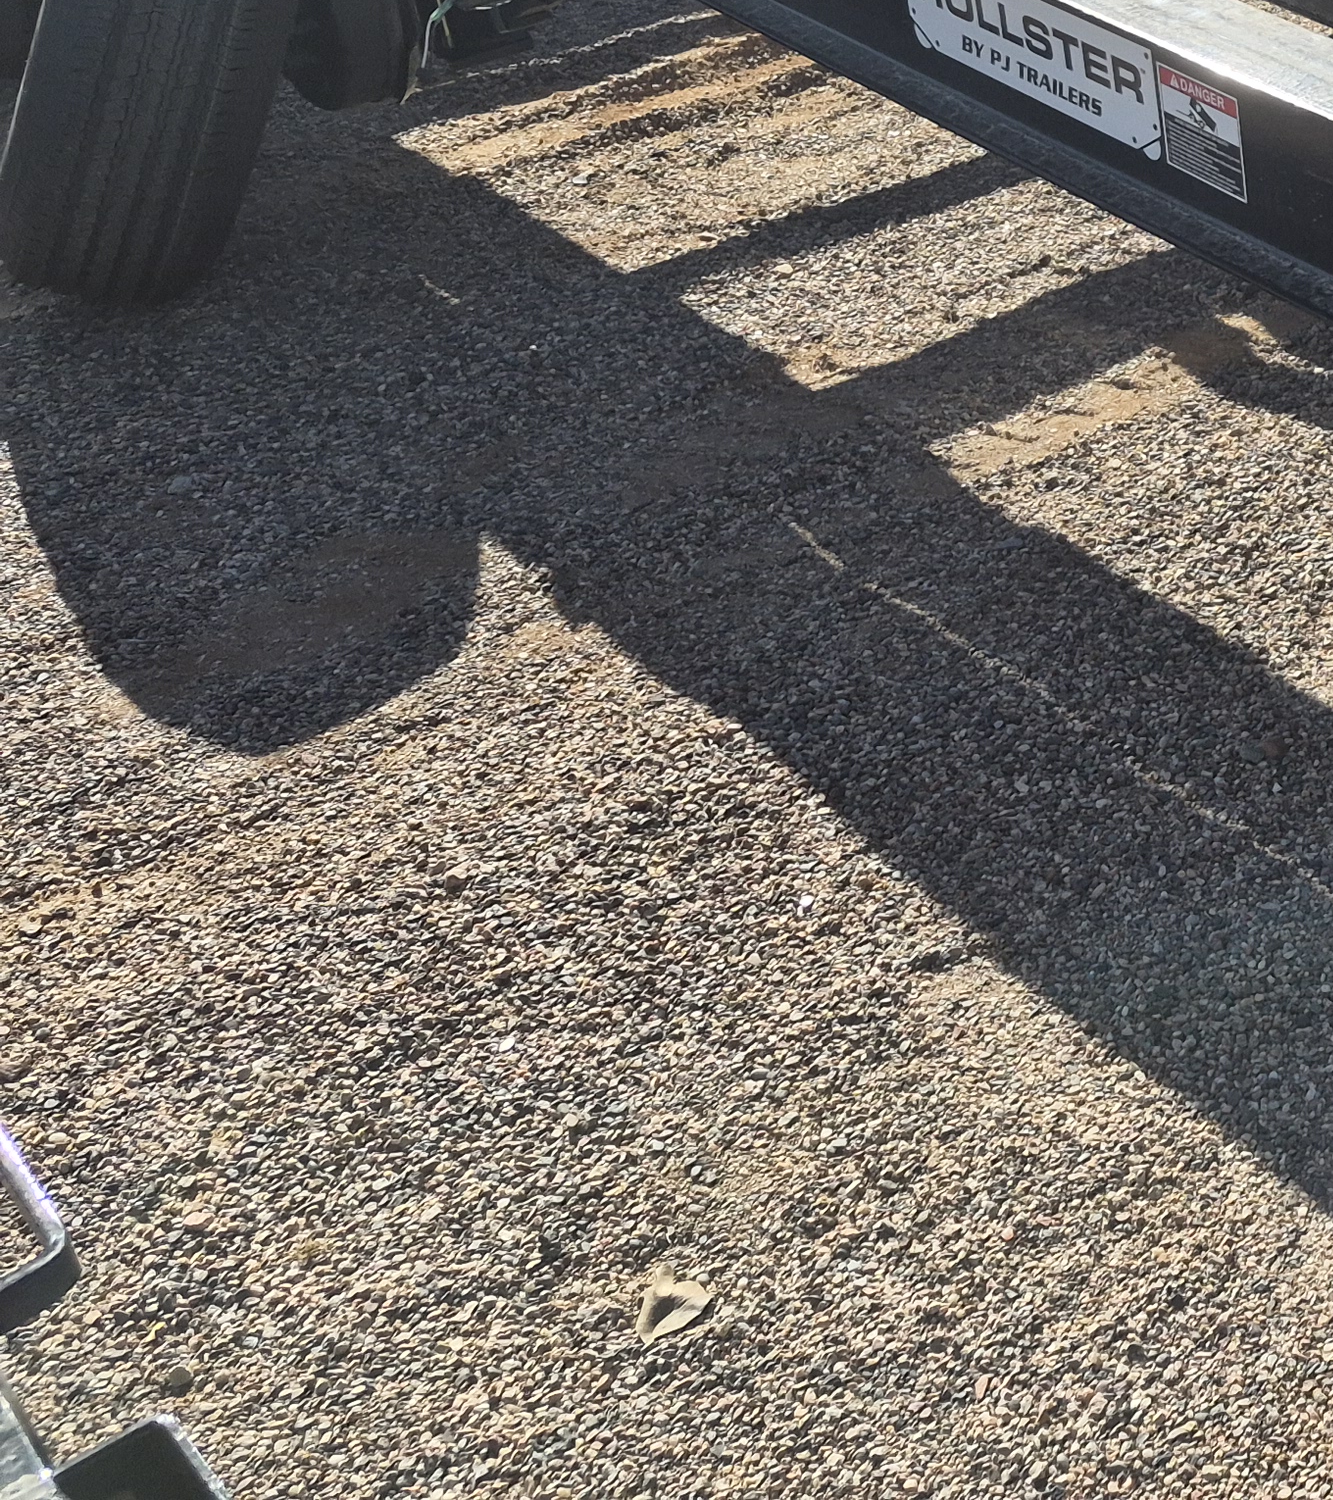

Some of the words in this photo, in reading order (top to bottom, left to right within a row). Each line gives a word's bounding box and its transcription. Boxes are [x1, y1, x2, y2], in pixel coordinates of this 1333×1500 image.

[961, 34, 984, 59] BY
[989, 47, 1011, 72] PJ
[1016, 60, 1103, 117] TRAILERS
[1180, 76, 1226, 110] DANGER
